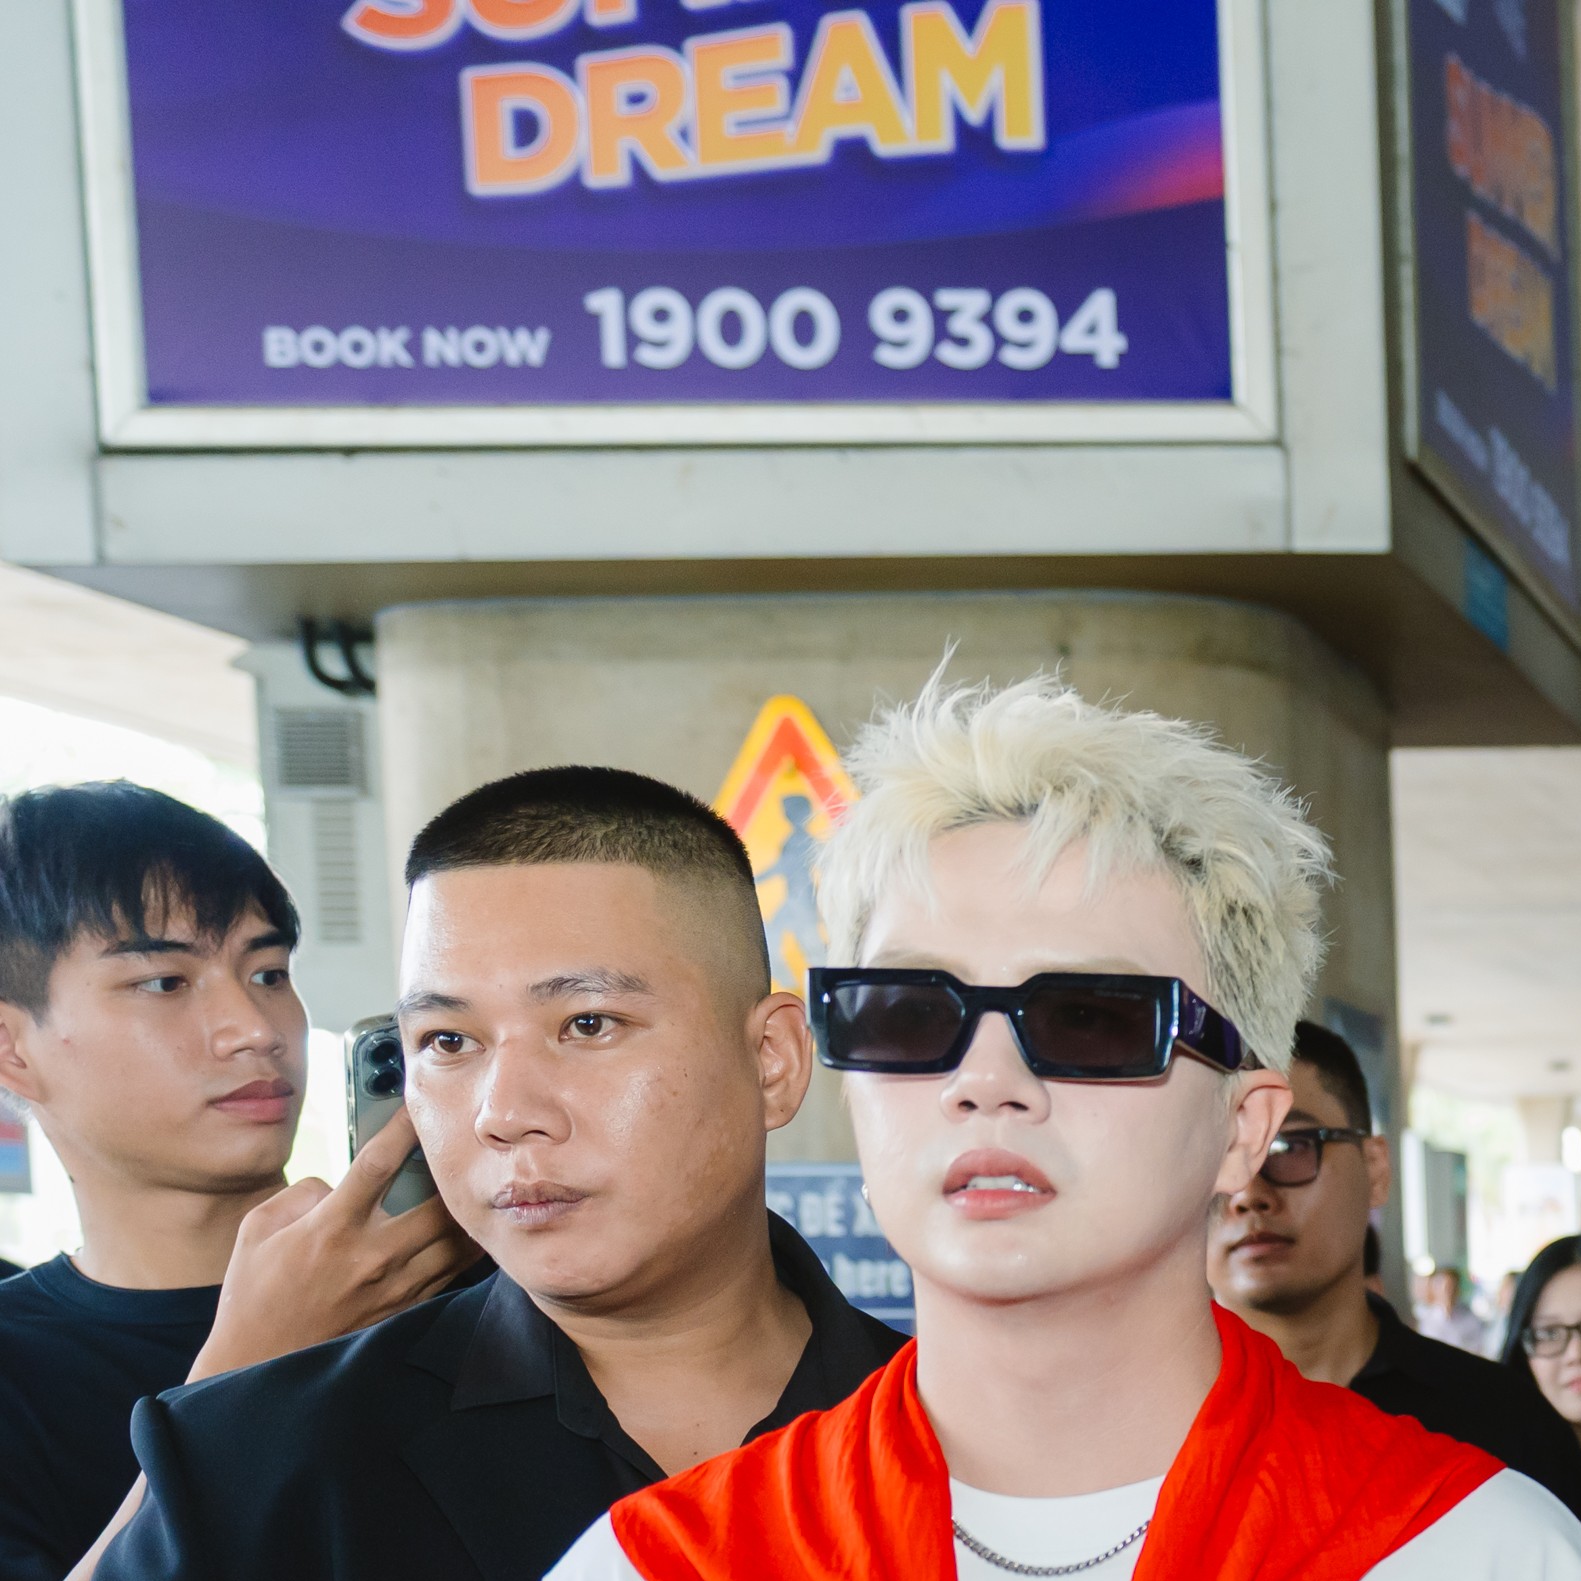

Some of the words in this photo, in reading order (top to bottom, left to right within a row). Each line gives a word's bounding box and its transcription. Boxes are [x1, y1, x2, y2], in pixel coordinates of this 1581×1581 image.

[460, 0, 1045, 196] DREAM
[262, 325, 415, 369] BOOK
[421, 325, 552, 369] NOW
[583, 286, 841, 370] 1900
[868, 286, 1129, 371] 9394
